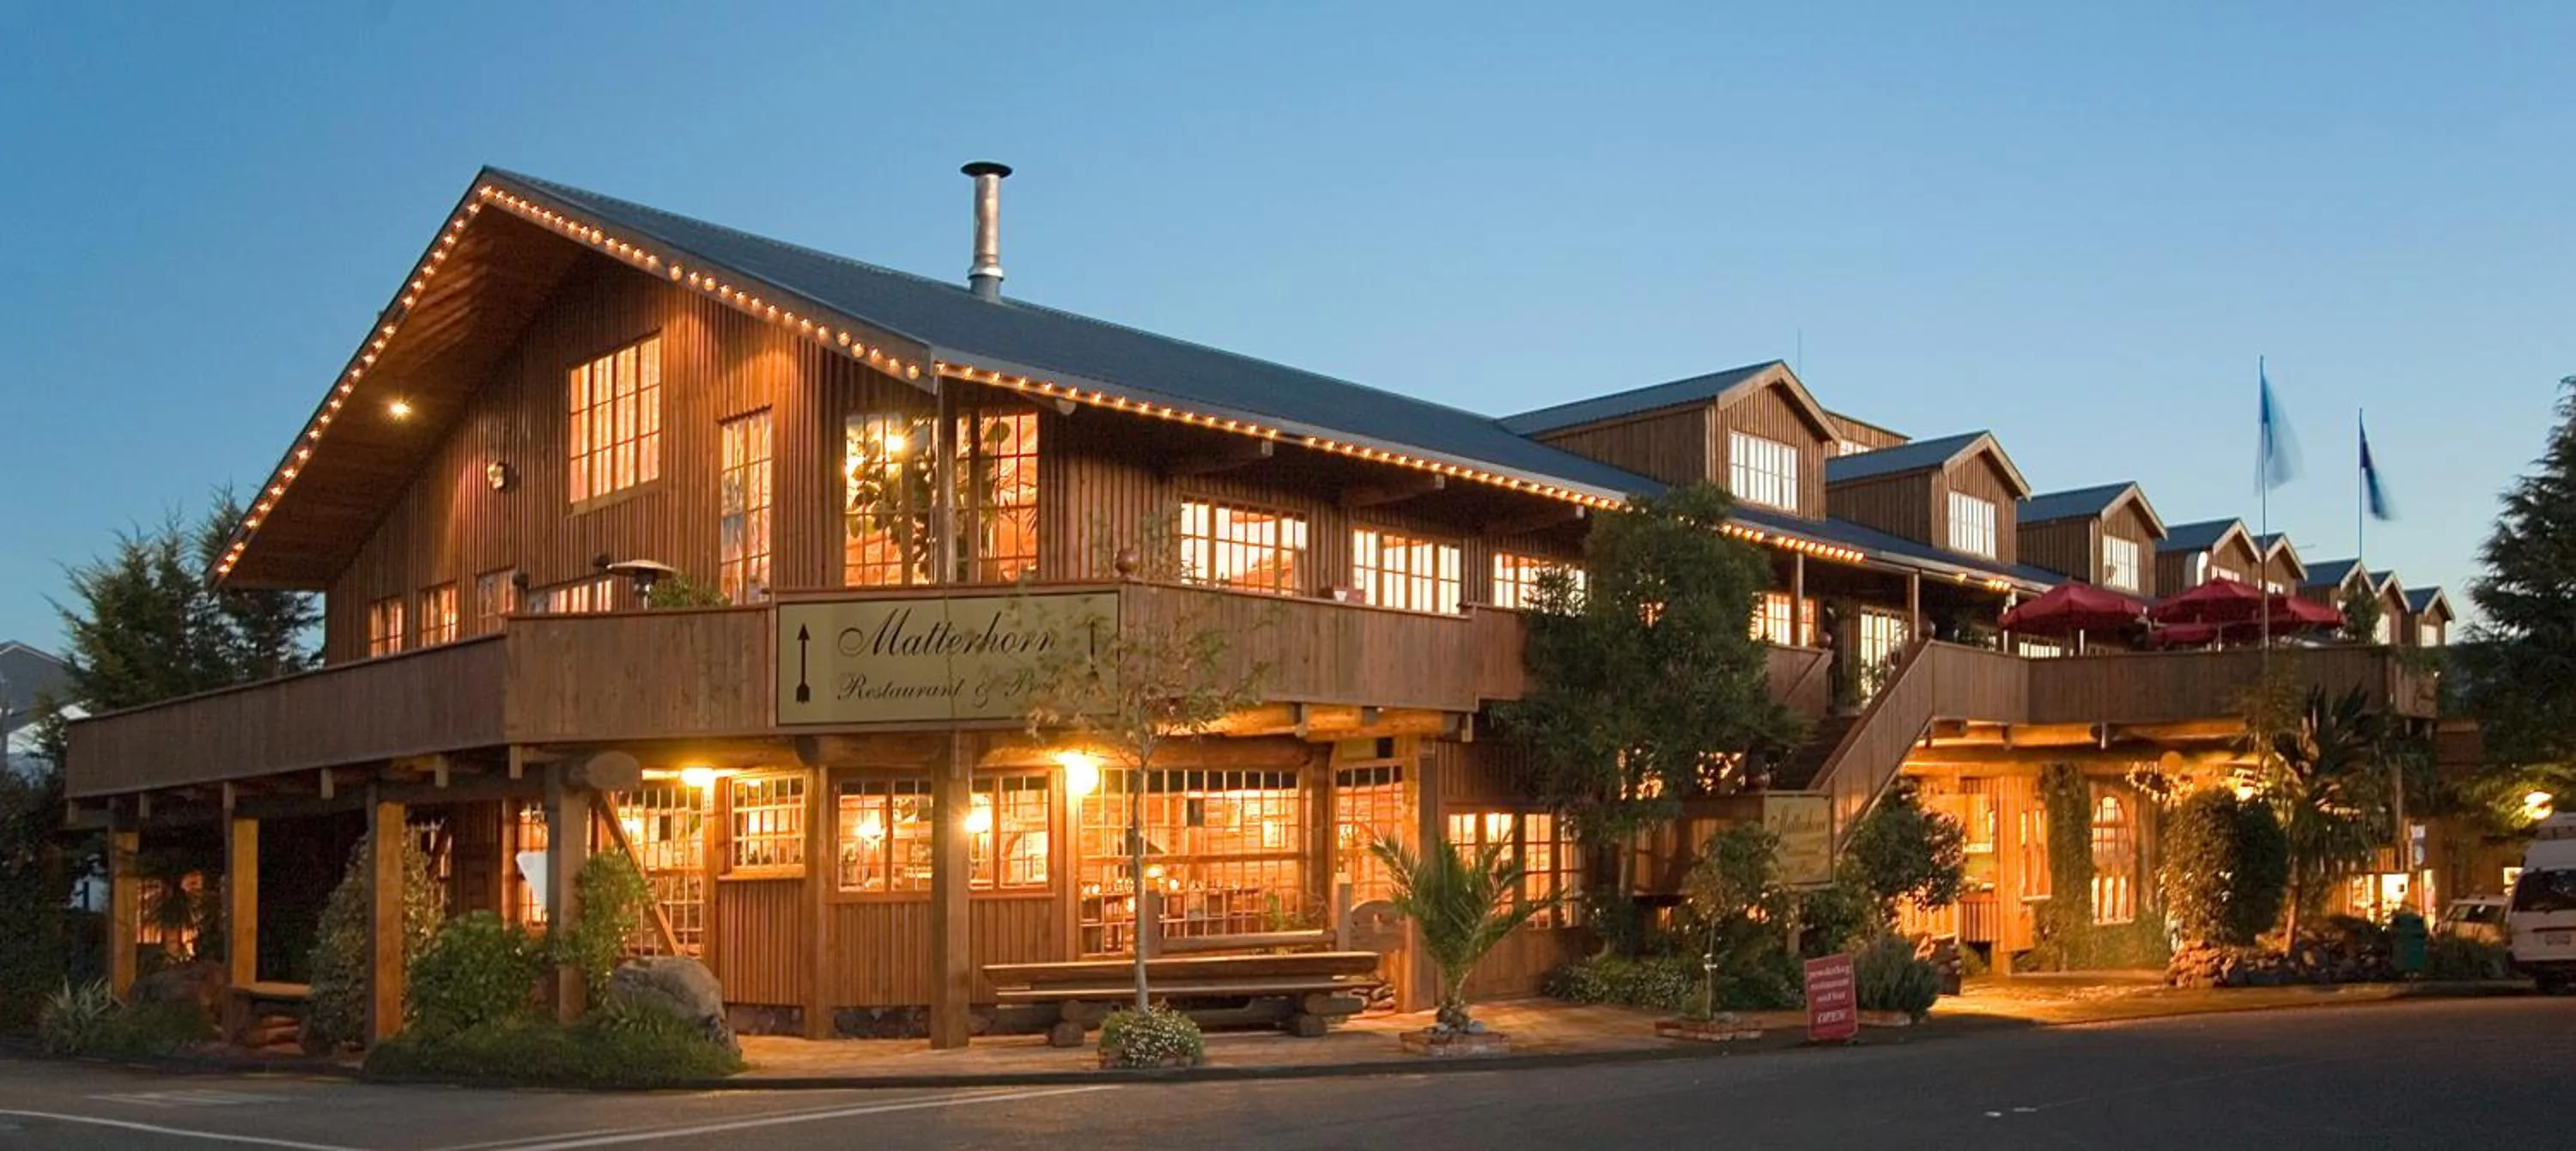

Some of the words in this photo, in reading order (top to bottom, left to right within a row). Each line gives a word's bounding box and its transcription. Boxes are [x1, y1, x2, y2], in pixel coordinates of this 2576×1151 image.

[837, 605, 1057, 658] Matterhorn
[837, 672, 963, 701] Restaurant
[1817, 1009, 1846, 1025] OPEN
